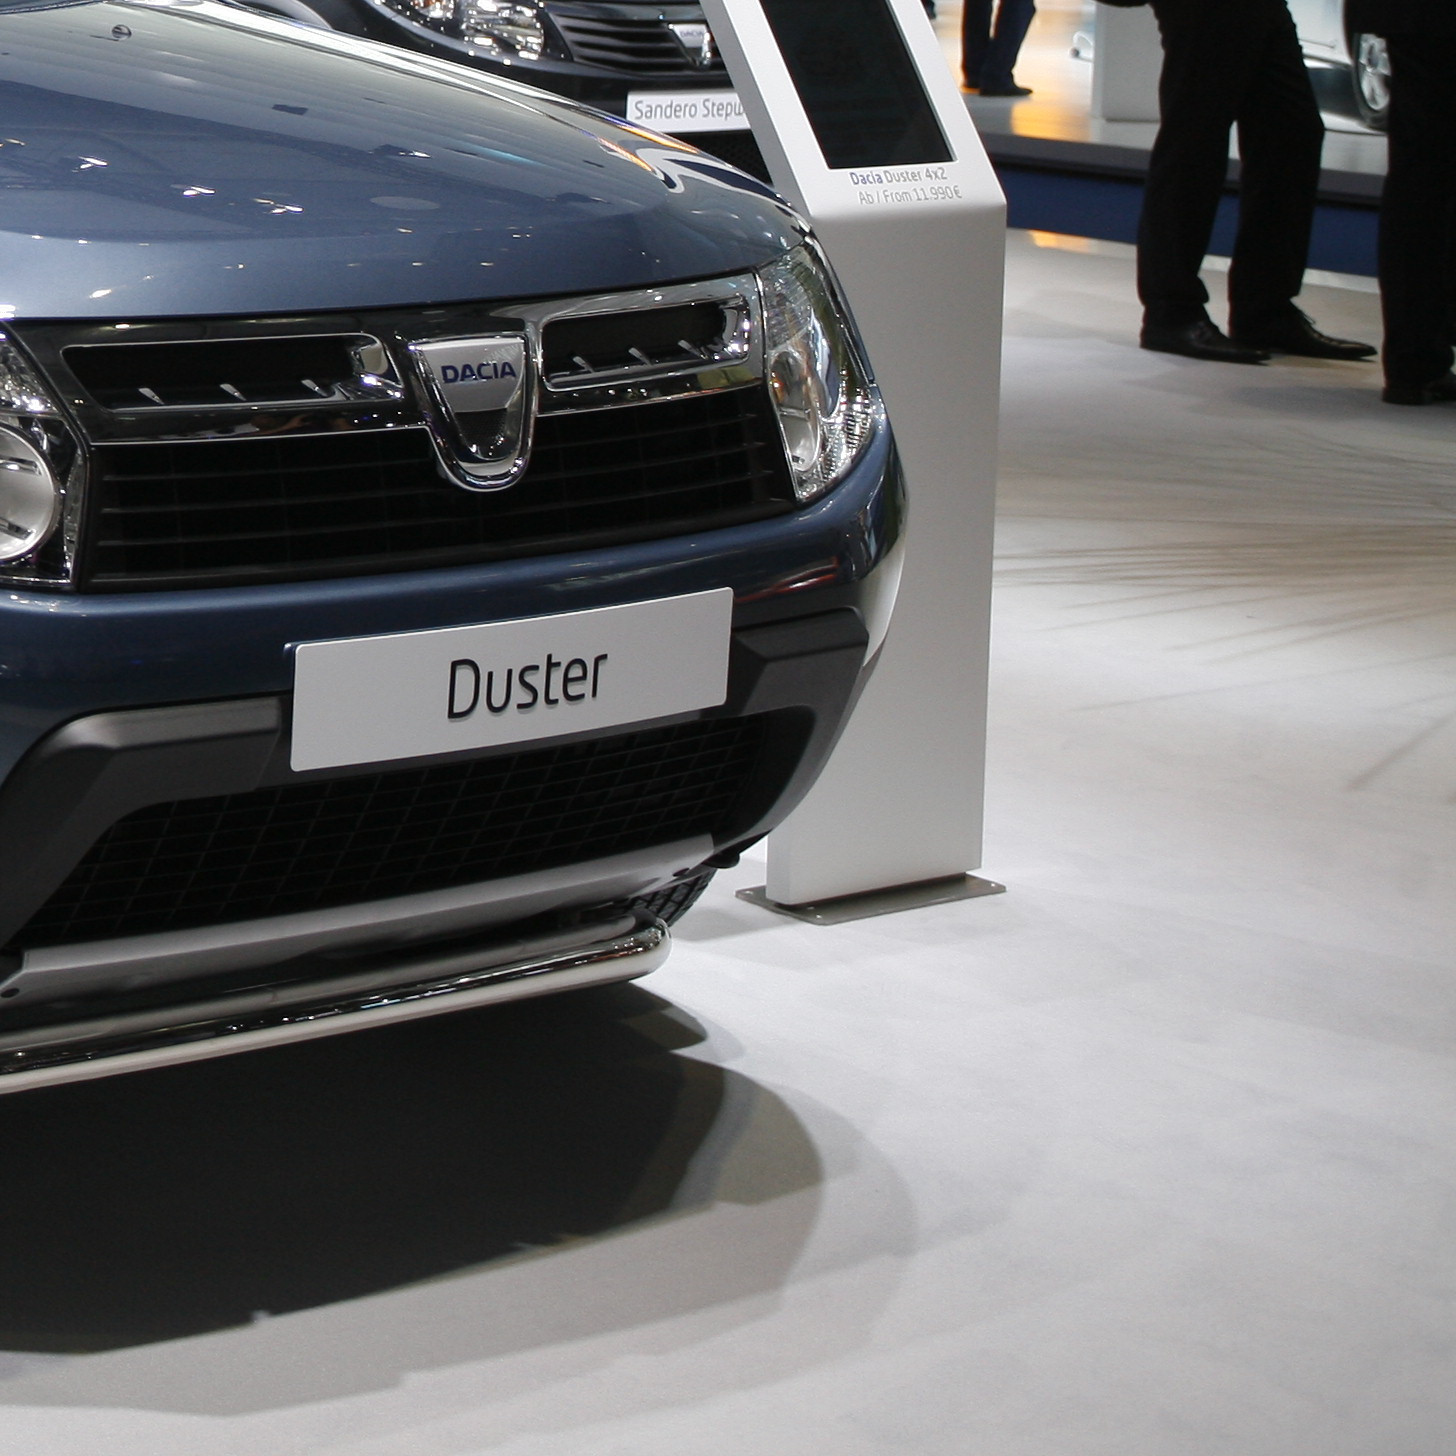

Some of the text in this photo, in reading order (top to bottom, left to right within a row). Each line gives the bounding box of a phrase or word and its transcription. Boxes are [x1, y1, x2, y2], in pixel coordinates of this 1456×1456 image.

[634, 97, 745, 121] Sandero Stepw
[849, 166, 948, 186] Dacia Duster 4x2
[858, 191, 874, 205] Ab
[883, 189, 912, 204] From
[441, 361, 517, 385] DACIA
[447, 652, 608, 720] Duster
